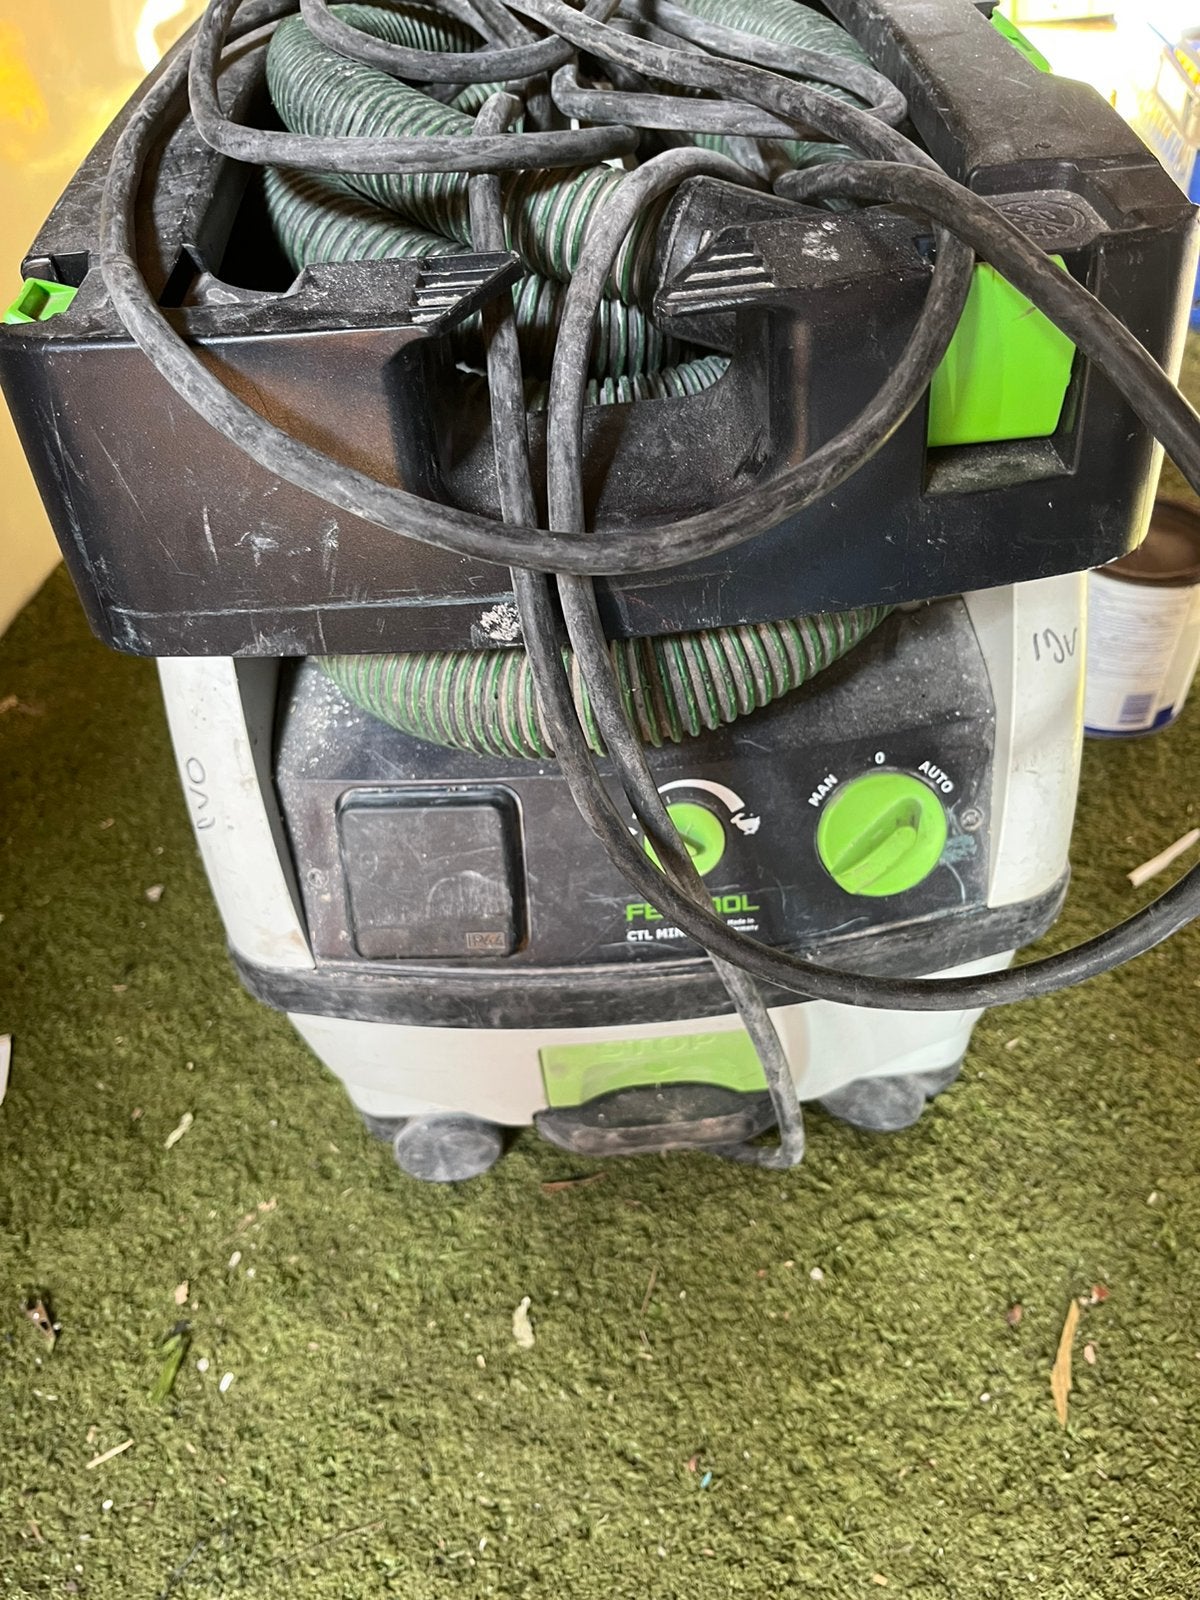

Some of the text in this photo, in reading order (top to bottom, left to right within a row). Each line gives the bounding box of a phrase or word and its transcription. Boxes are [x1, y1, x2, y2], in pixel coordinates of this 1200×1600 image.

[808, 773, 838, 807] MAN
[918, 760, 954, 794] AUTO
[626, 929, 653, 942] CTL
